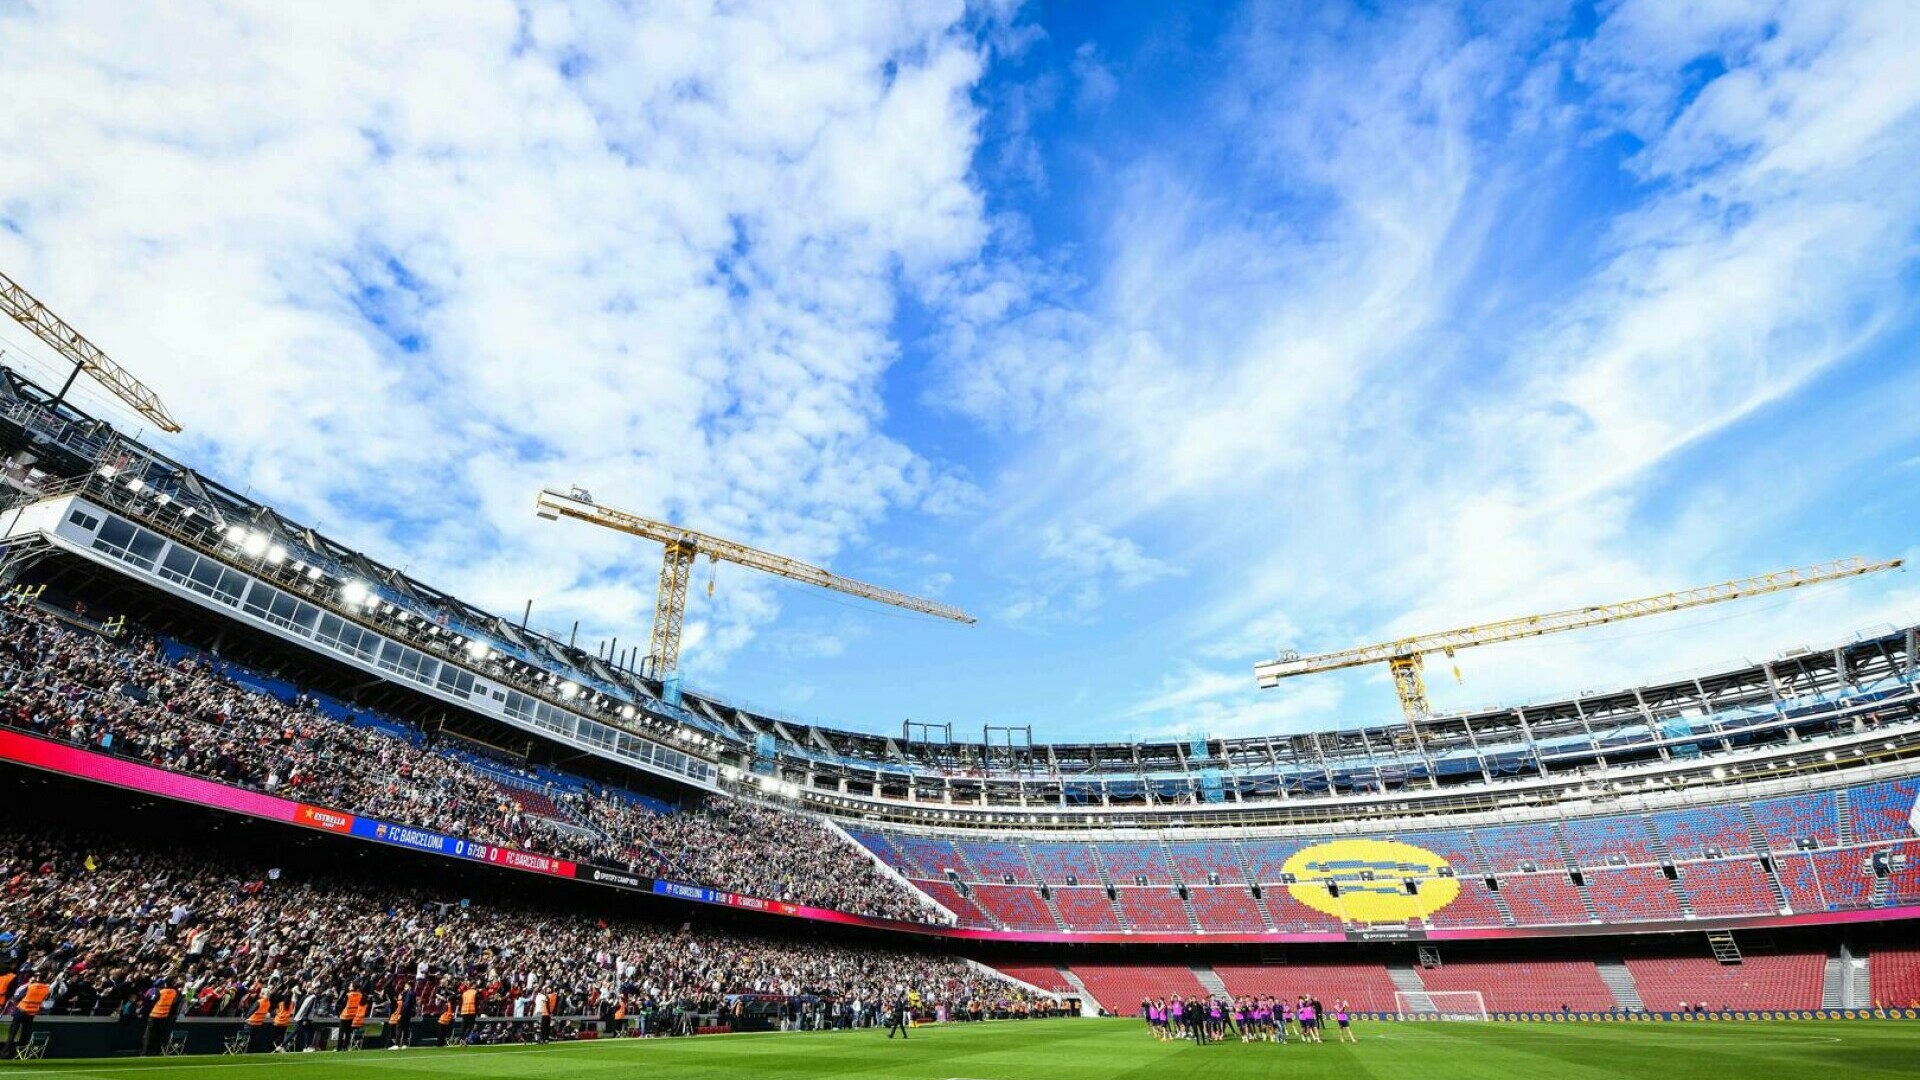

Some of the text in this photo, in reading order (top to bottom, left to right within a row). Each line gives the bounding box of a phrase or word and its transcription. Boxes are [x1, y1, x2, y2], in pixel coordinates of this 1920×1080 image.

[314, 812, 346, 826] ESTRELLA
[389, 827, 549, 871] FC BARCELONA 0 67:09 0 FC BARCELONA
[709, 890, 714, 901] 0
[728, 894, 733, 905] 0
